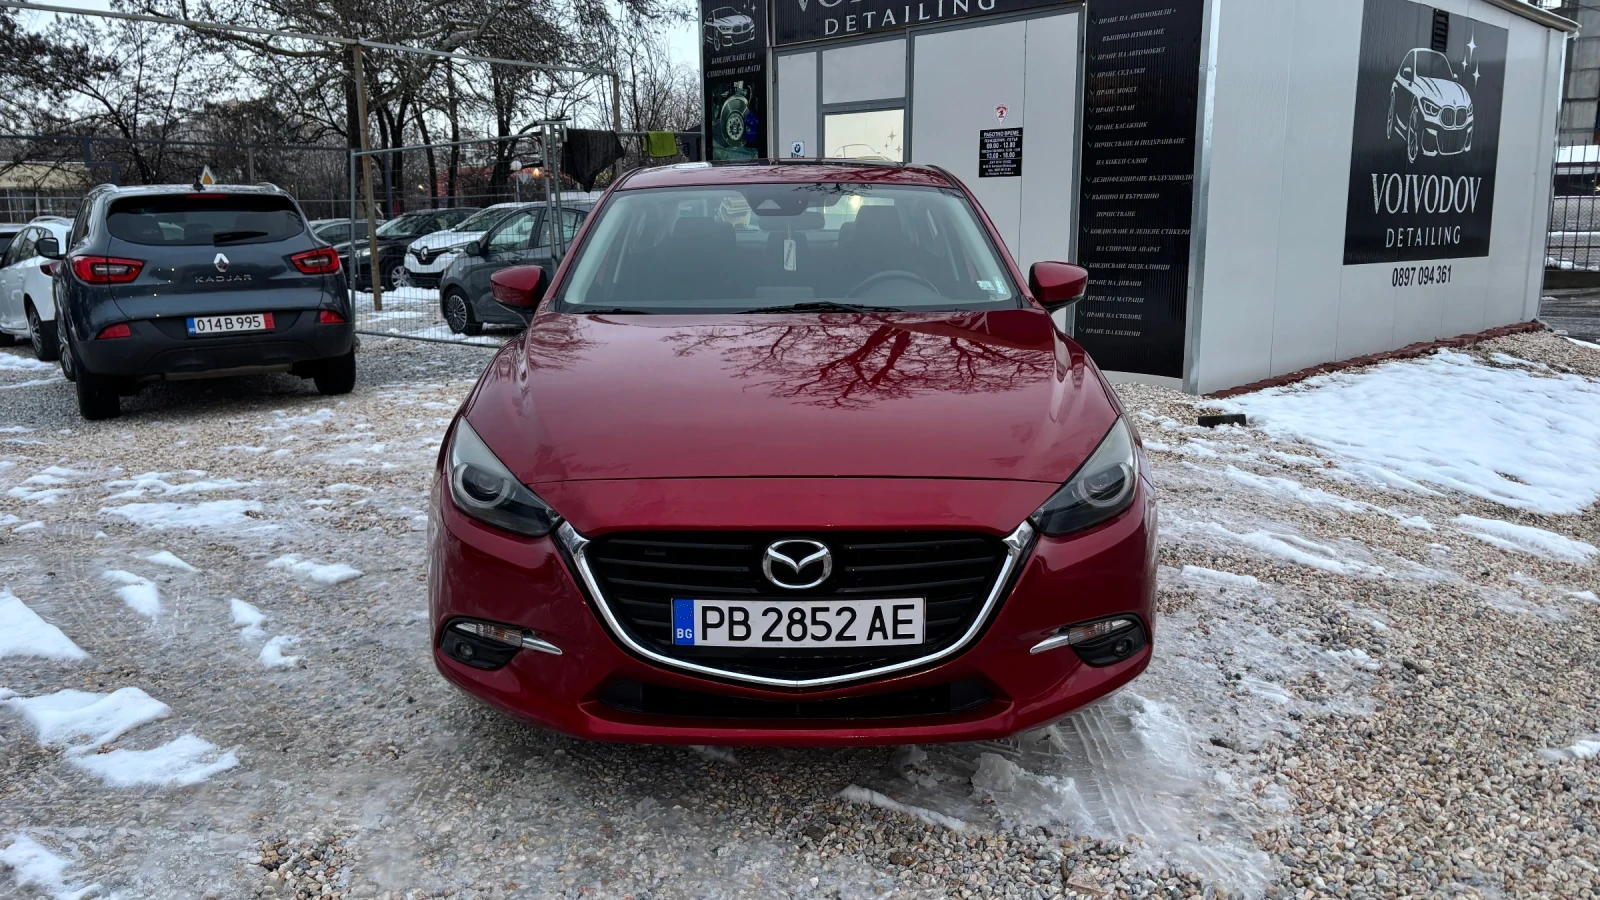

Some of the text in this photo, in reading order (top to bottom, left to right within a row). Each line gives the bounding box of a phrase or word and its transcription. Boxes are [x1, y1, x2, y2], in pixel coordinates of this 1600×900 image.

[824, 0, 995, 35] DETAILING
[1371, 173, 1482, 214] VOIVODOV
[1385, 226, 1461, 248] DETAILING
[195, 274, 252, 283] KADJAR
[1392, 264, 1452, 287] 0897 094 361
[196, 318, 222, 332] 014
[224, 317, 234, 331] B
[236, 315, 261, 329] 995
[676, 603, 916, 642] BG PB 2852 AE
